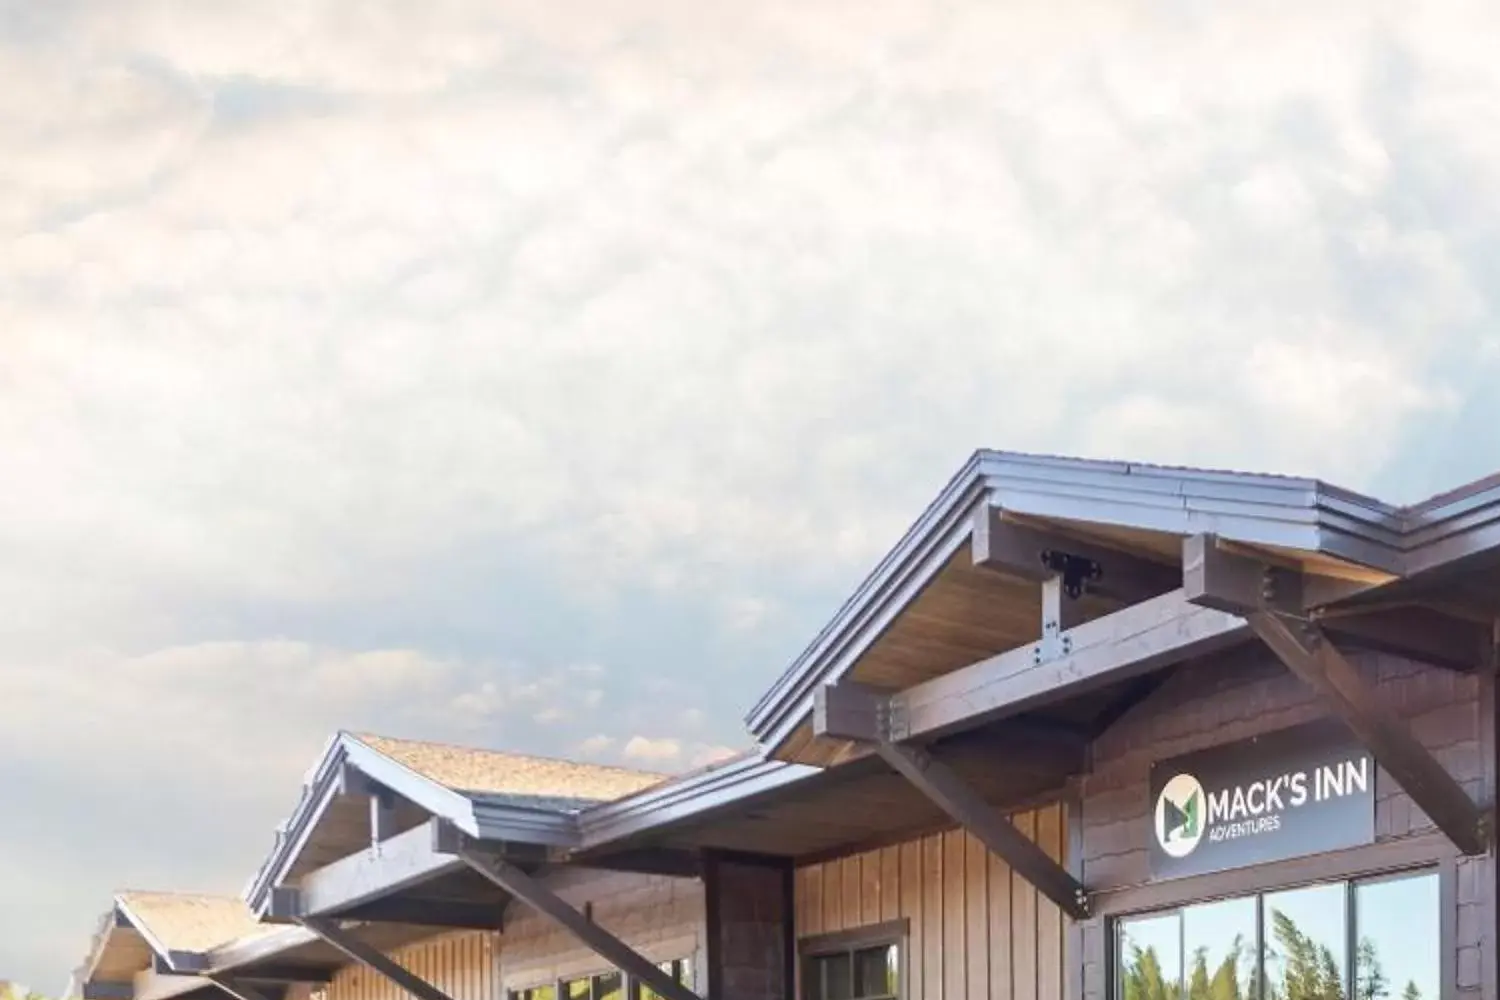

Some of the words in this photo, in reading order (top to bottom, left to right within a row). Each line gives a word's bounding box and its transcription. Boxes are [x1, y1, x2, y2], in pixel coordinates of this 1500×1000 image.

[1208, 772, 1307, 824] MACK'S
[1315, 757, 1368, 801] INN
[1209, 815, 1281, 842] ADVENTURES
